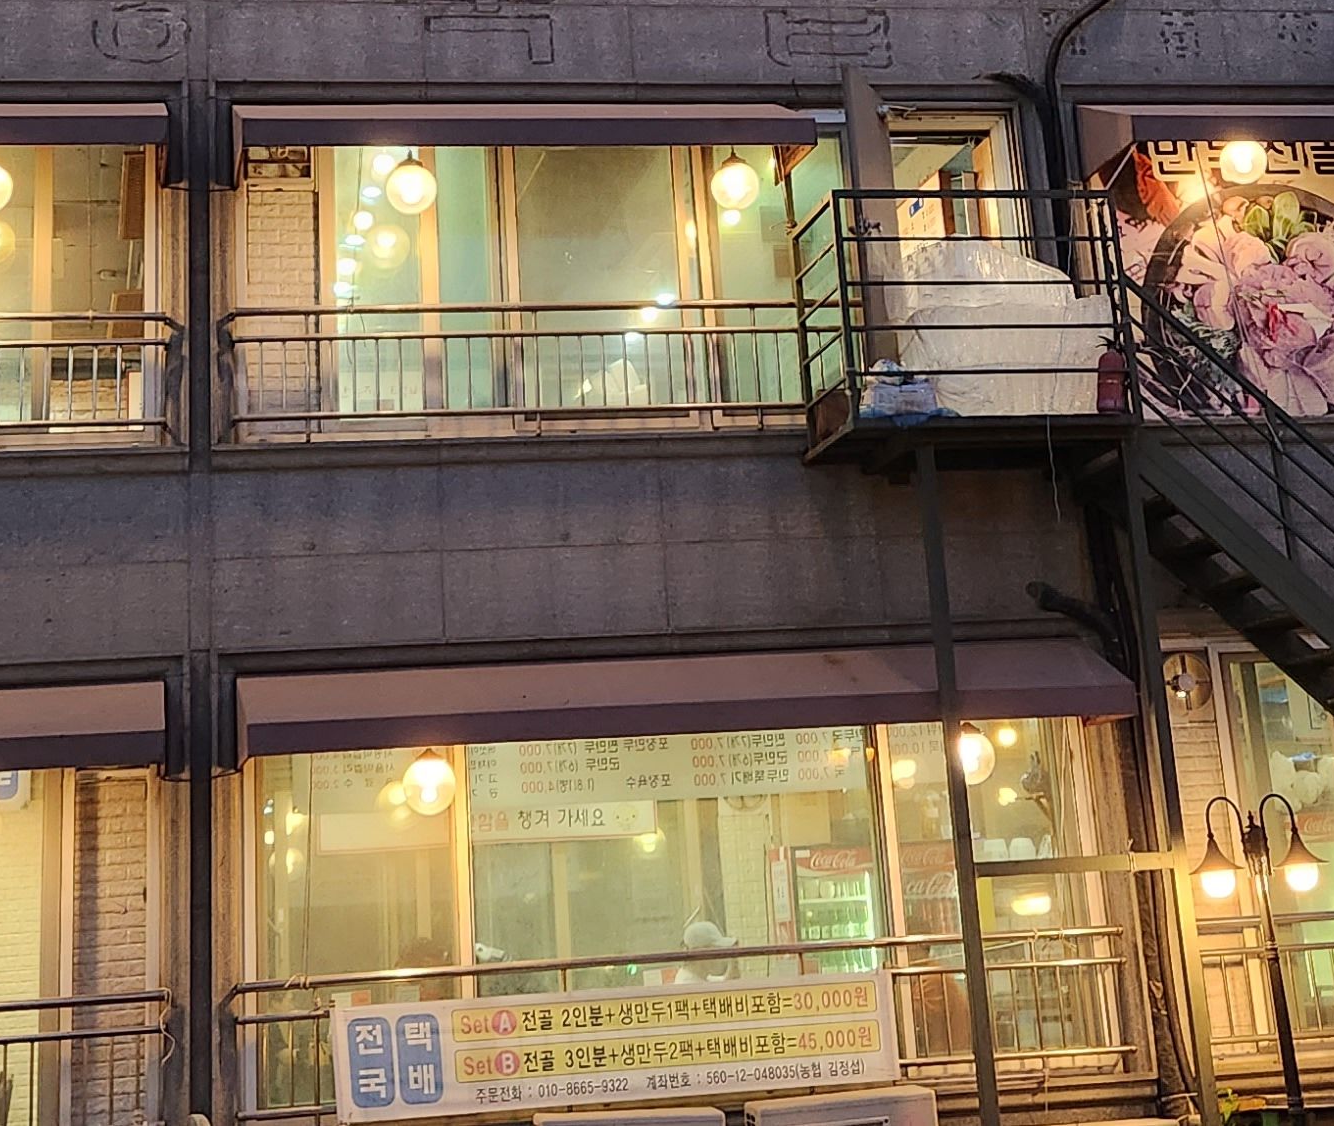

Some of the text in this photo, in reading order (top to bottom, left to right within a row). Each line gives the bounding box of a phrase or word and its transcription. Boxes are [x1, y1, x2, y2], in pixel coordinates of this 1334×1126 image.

[518, 809, 550, 830] 챙겨
[557, 808, 606, 828] 가세요
[460, 1016, 490, 1035] Set
[522, 1009, 554, 1033] 전골
[354, 1023, 388, 1099] 전국
[403, 1020, 436, 1095] 택배
[463, 1056, 493, 1076] Set
[523, 1049, 555, 1073] 전골
[475, 1084, 523, 1103] 주문전화
[538, 1077, 630, 1099] 010-8665-9322
[645, 1073, 692, 1090] 계좌번호
